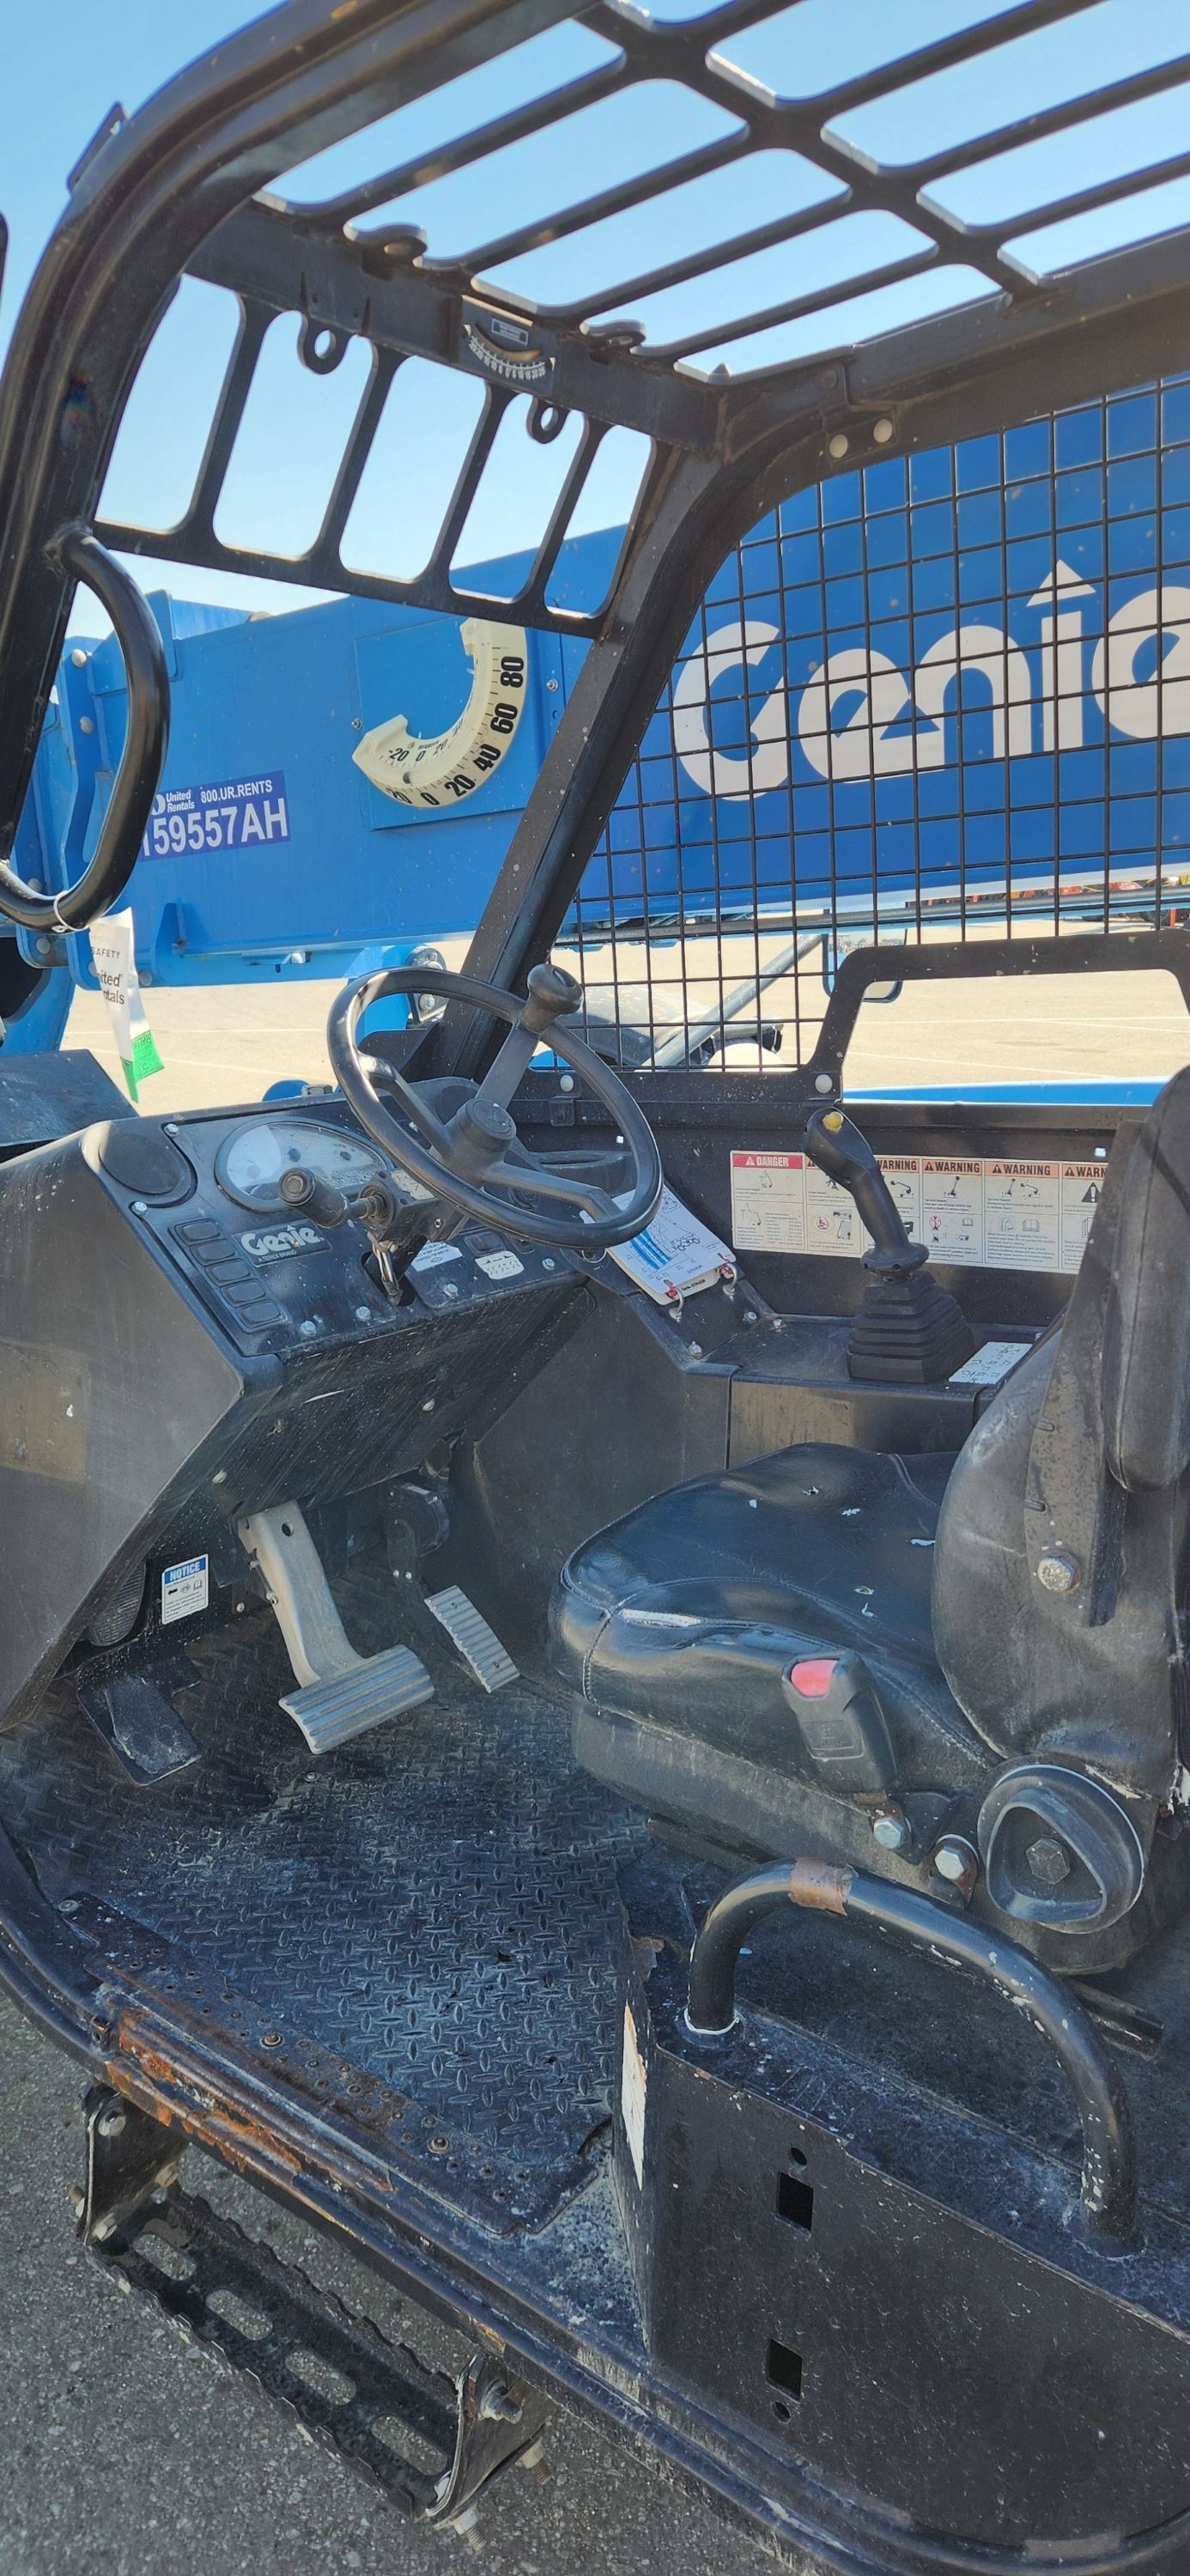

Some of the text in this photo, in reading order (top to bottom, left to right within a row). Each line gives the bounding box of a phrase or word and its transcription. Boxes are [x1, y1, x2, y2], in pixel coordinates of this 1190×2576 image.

[500, 656, 525, 688] 80
[673, 559, 1190, 801] Genie
[489, 702, 519, 735] 60
[389, 747, 410, 762] -20
[416, 750, 427, 762] 0
[472, 744, 501, 772] 40
[200, 780, 273, 804] 800.UR.RENTS
[444, 774, 476, 798] 20
[166, 788, 191, 803] United
[420, 792, 440, 805] 0
[167, 799, 195, 813] Rentals
[91, 946, 120, 959] SAFETY
[756, 1156, 789, 1167] DANGER
[935, 1161, 980, 1173] WARNING
[1003, 1163, 1051, 1176] WARNING
[1076, 1166, 1106, 1178] WARN
[241, 1225, 321, 1256] Genie
[169, 1561, 201, 1581] NOTICE
